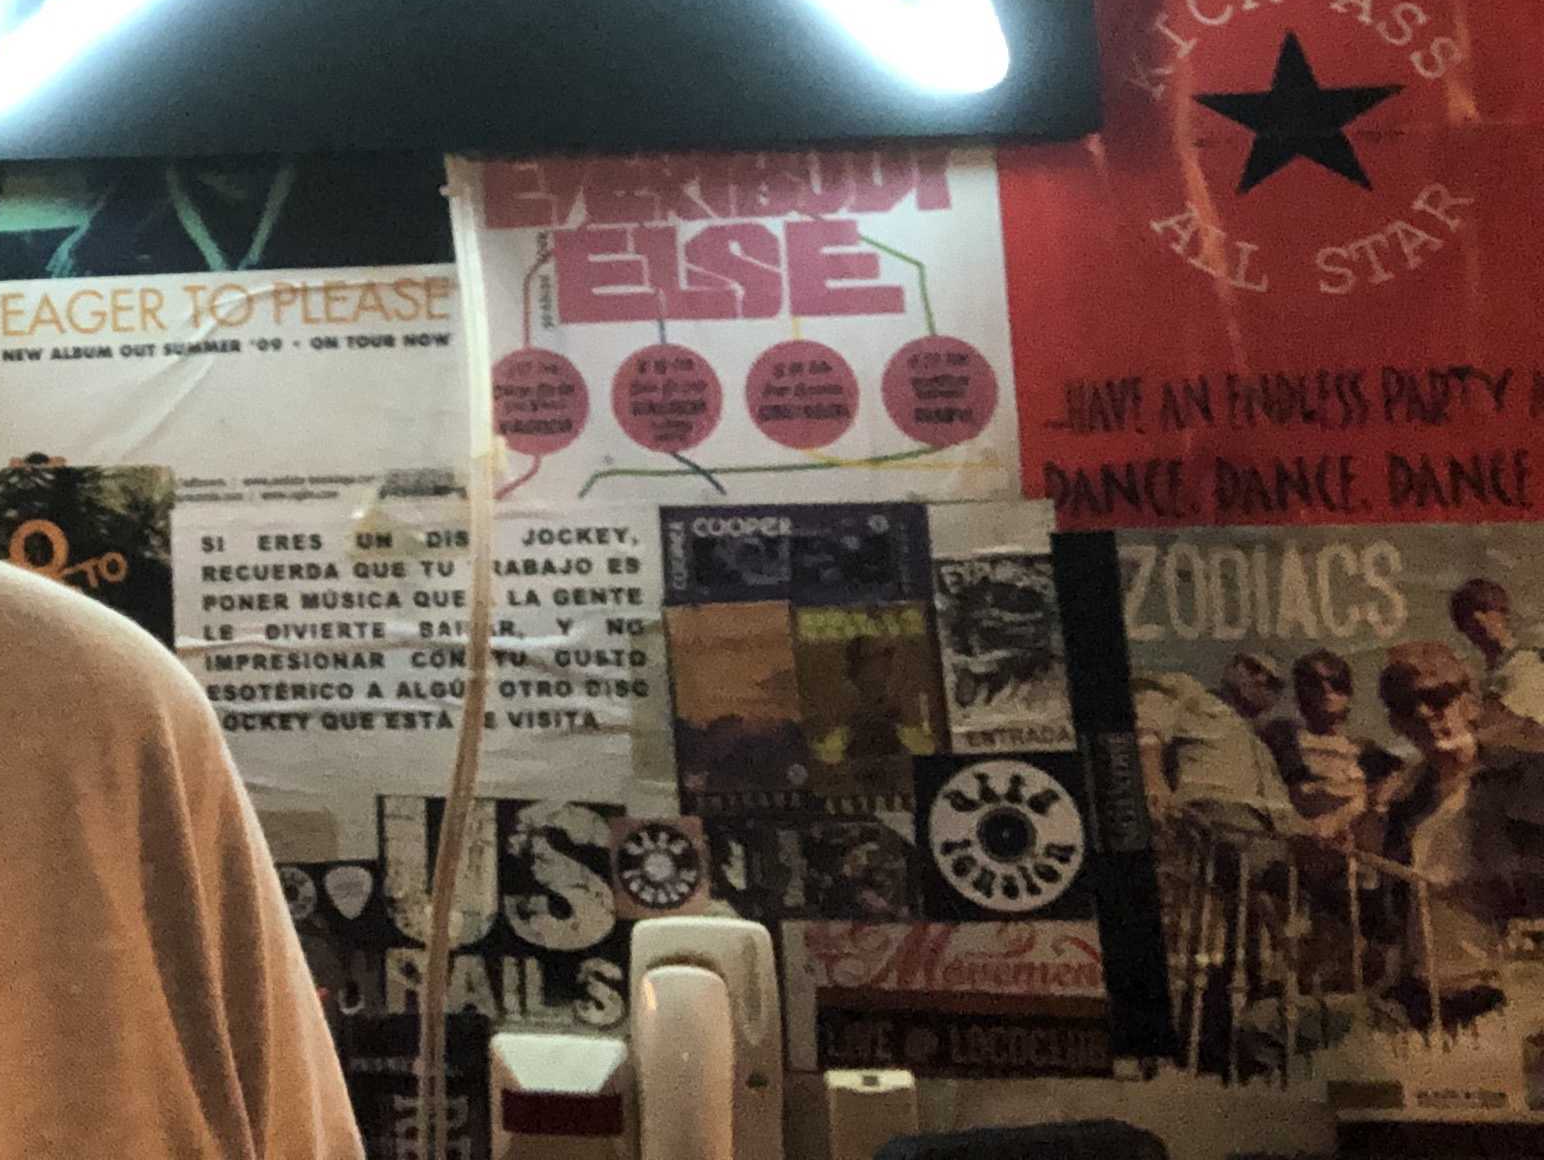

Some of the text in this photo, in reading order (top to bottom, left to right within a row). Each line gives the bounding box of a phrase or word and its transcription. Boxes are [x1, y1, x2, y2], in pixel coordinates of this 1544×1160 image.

[1150, 183, 1474, 294] ALL STAR
[556, 219, 905, 324] ELSE
[0, 276, 452, 337] EAGER TO PLEASE
[2, 347, 43, 363] NEW
[51, 345, 112, 361] ALBUM
[119, 343, 157, 358] OUT
[163, 339, 242, 357] SUMMER
[310, 336, 339, 351] ON
[346, 334, 396, 349] TOUR
[402, 332, 452, 347] NOW
[1160, 374, 1214, 431] AN
[1225, 367, 1369, 430] ENDLESS
[1382, 365, 1513, 426] PARTY
[1387, 448, 1534, 510] DANCE
[693, 516, 793, 537] COOPER
[201, 536, 225, 553] SI
[258, 534, 323, 552] ERES
[359, 532, 393, 549] UN
[426, 530, 472, 549] DIS
[202, 562, 339, 583] RECUERDA
[353, 562, 406, 579] QUE
[420, 560, 455, 578] TU
[608, 556, 640, 575] ES
[203, 586, 643, 612] PONER MÚSICA QUE LA GENTE
[1118, 539, 1408, 641] ZODIACS
[204, 623, 234, 642] LE
[265, 621, 386, 640] DIVIERTE
[556, 617, 574, 636] Y
[606, 617, 645, 636] NO
[205, 648, 647, 672] IMPRESIONAR CON TU GUSTO
[207, 678, 650, 702] ESOTÉRICO A ALGÚ OTRO DISC
[222, 711, 312, 730] OCKEY
[321, 710, 375, 730] QUE
[381, 794, 617, 950] US
